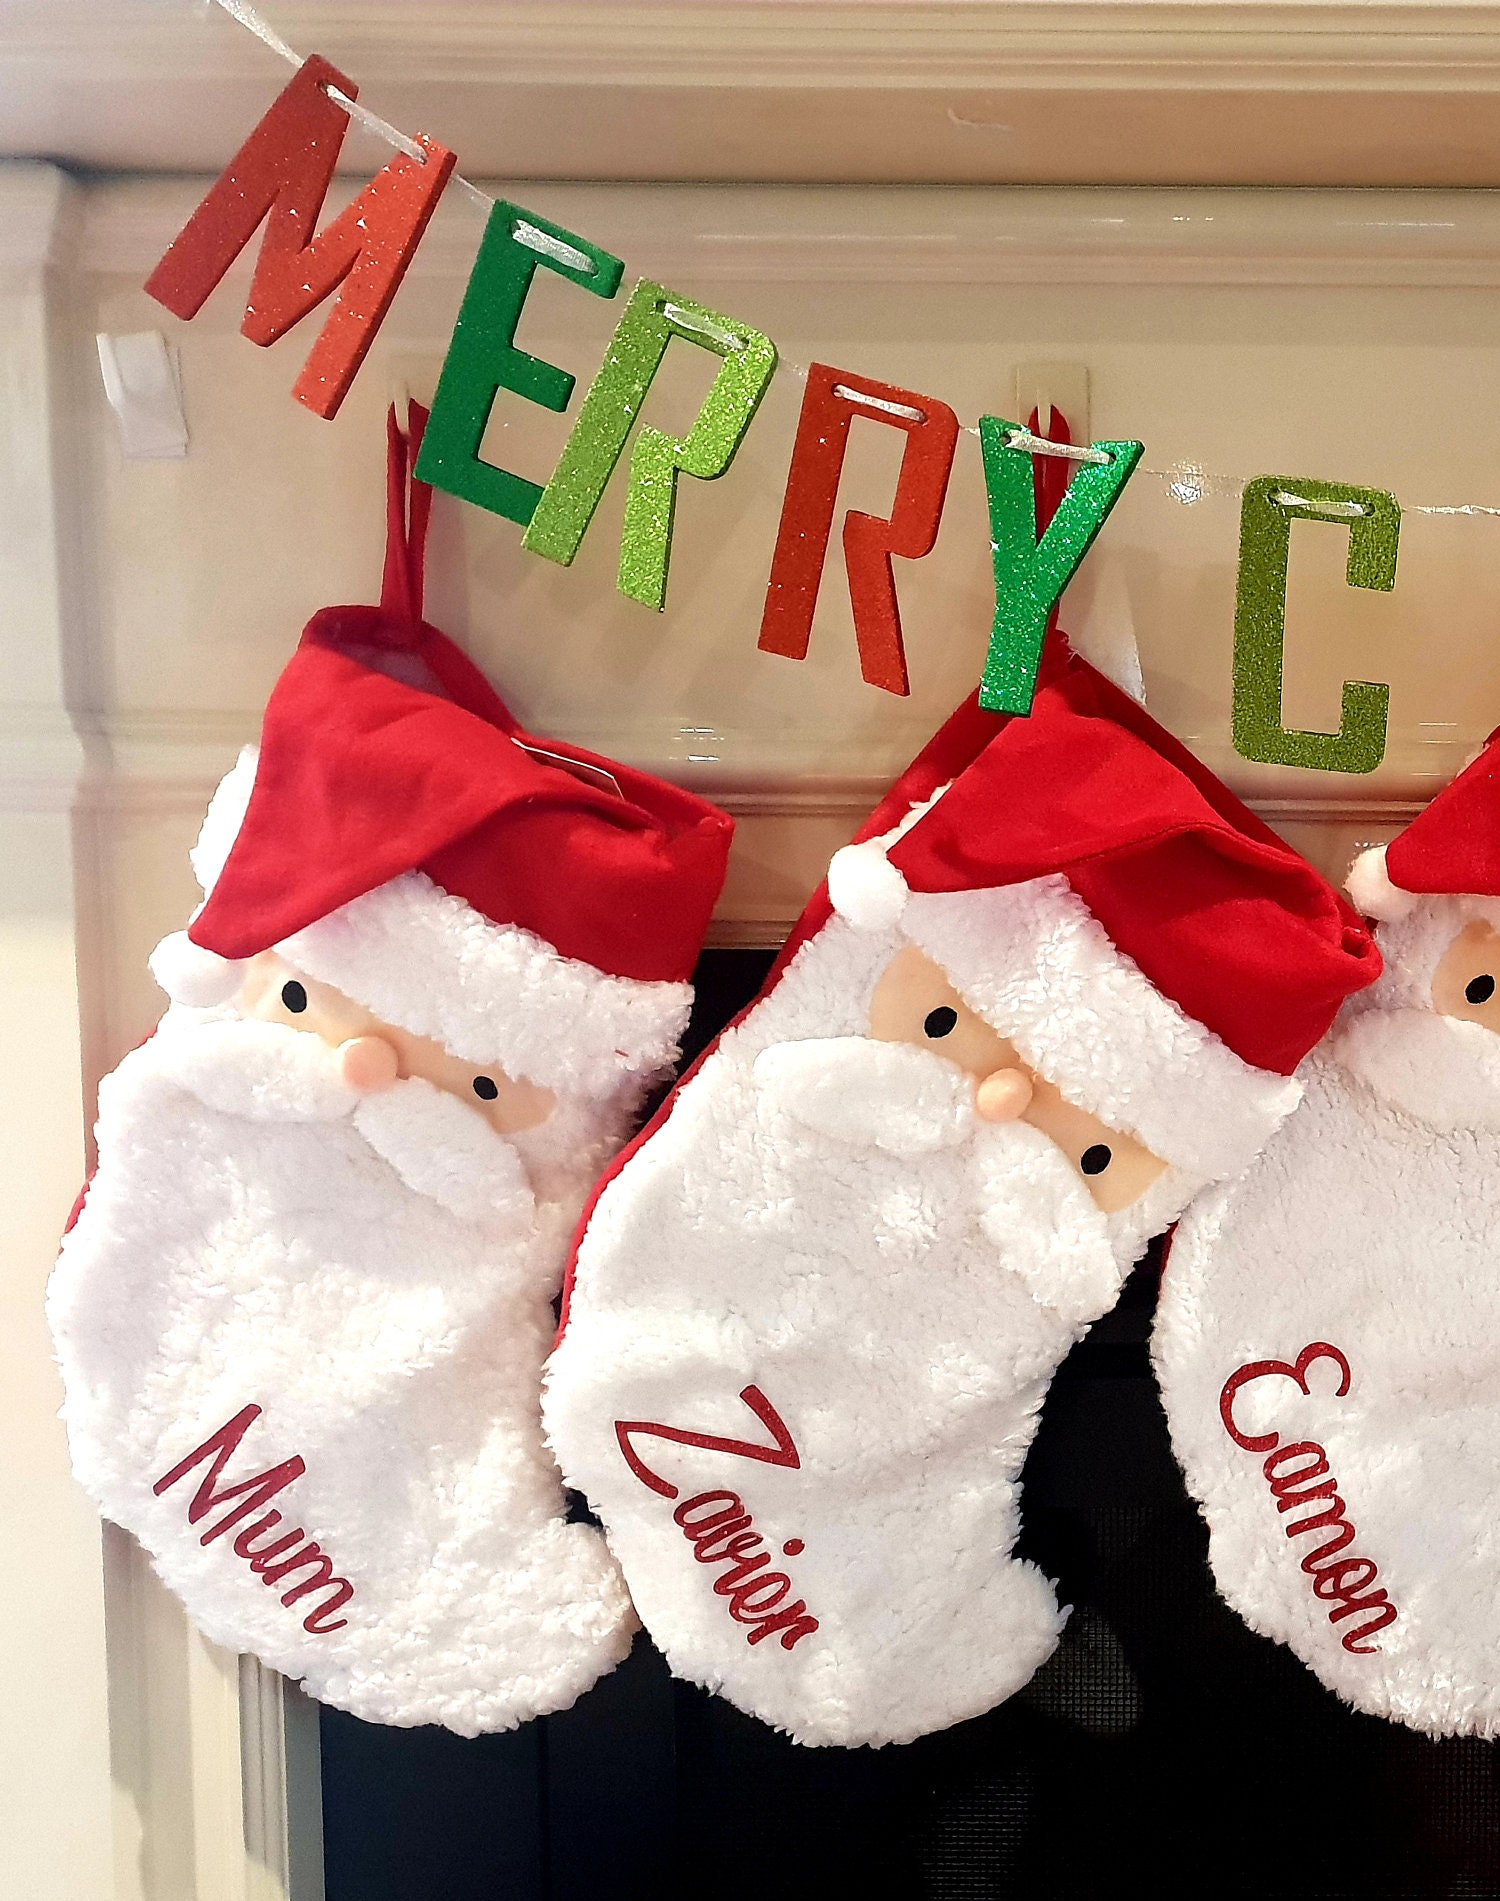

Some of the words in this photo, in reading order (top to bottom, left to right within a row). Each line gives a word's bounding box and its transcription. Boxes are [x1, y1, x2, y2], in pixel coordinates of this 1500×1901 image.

[144, 53, 1144, 717] MERRY
[153, 1403, 355, 1634] Mum
[614, 1384, 820, 1651] Zavier
[1219, 1341, 1398, 1654] Eamon
